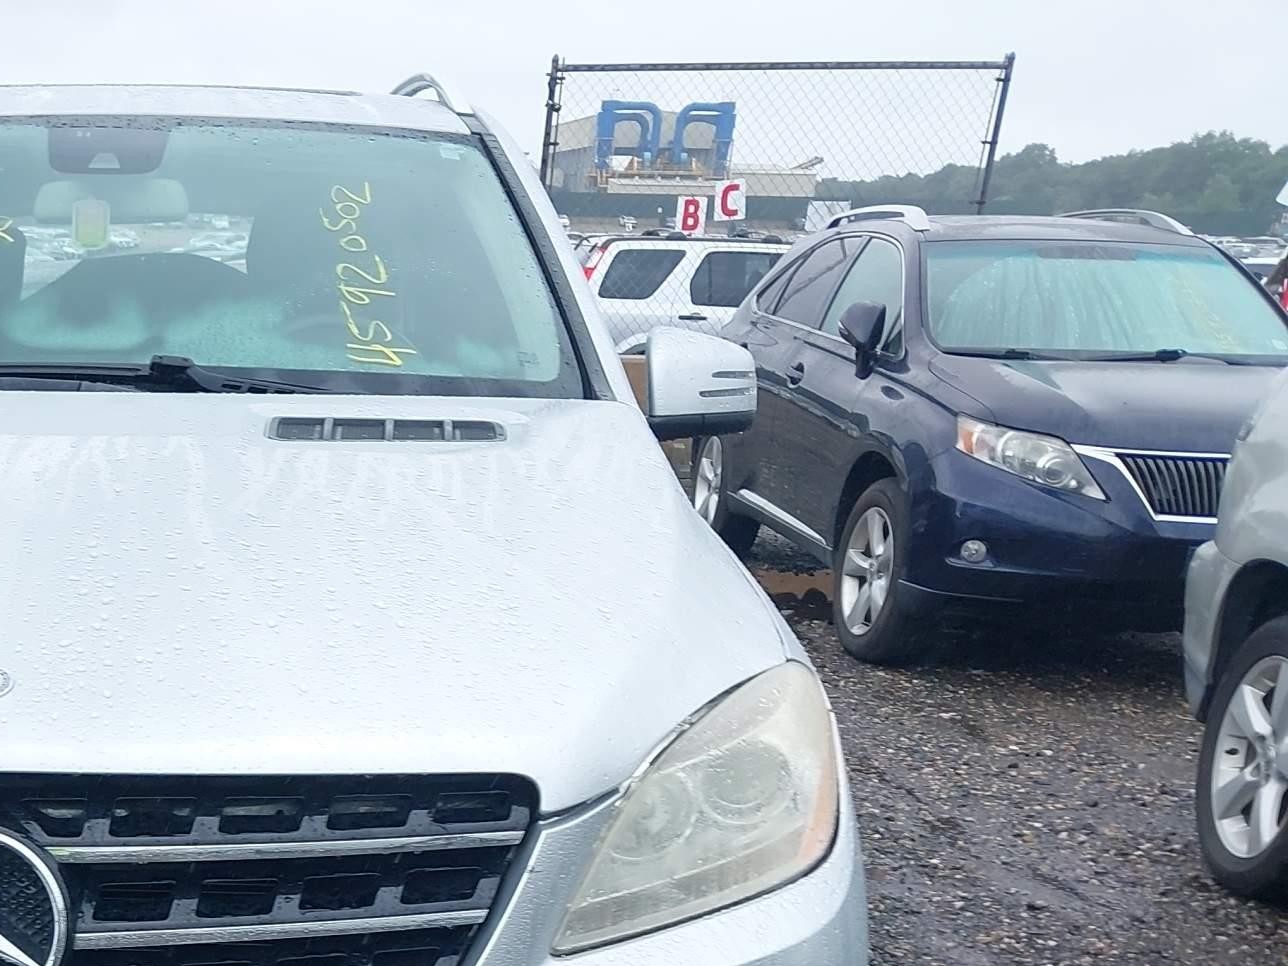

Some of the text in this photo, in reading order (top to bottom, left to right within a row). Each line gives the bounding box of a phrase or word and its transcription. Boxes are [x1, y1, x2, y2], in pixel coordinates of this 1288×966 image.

[681, 198, 700, 232] B
[720, 183, 740, 217] C
[319, 181, 417, 366] 45920502
